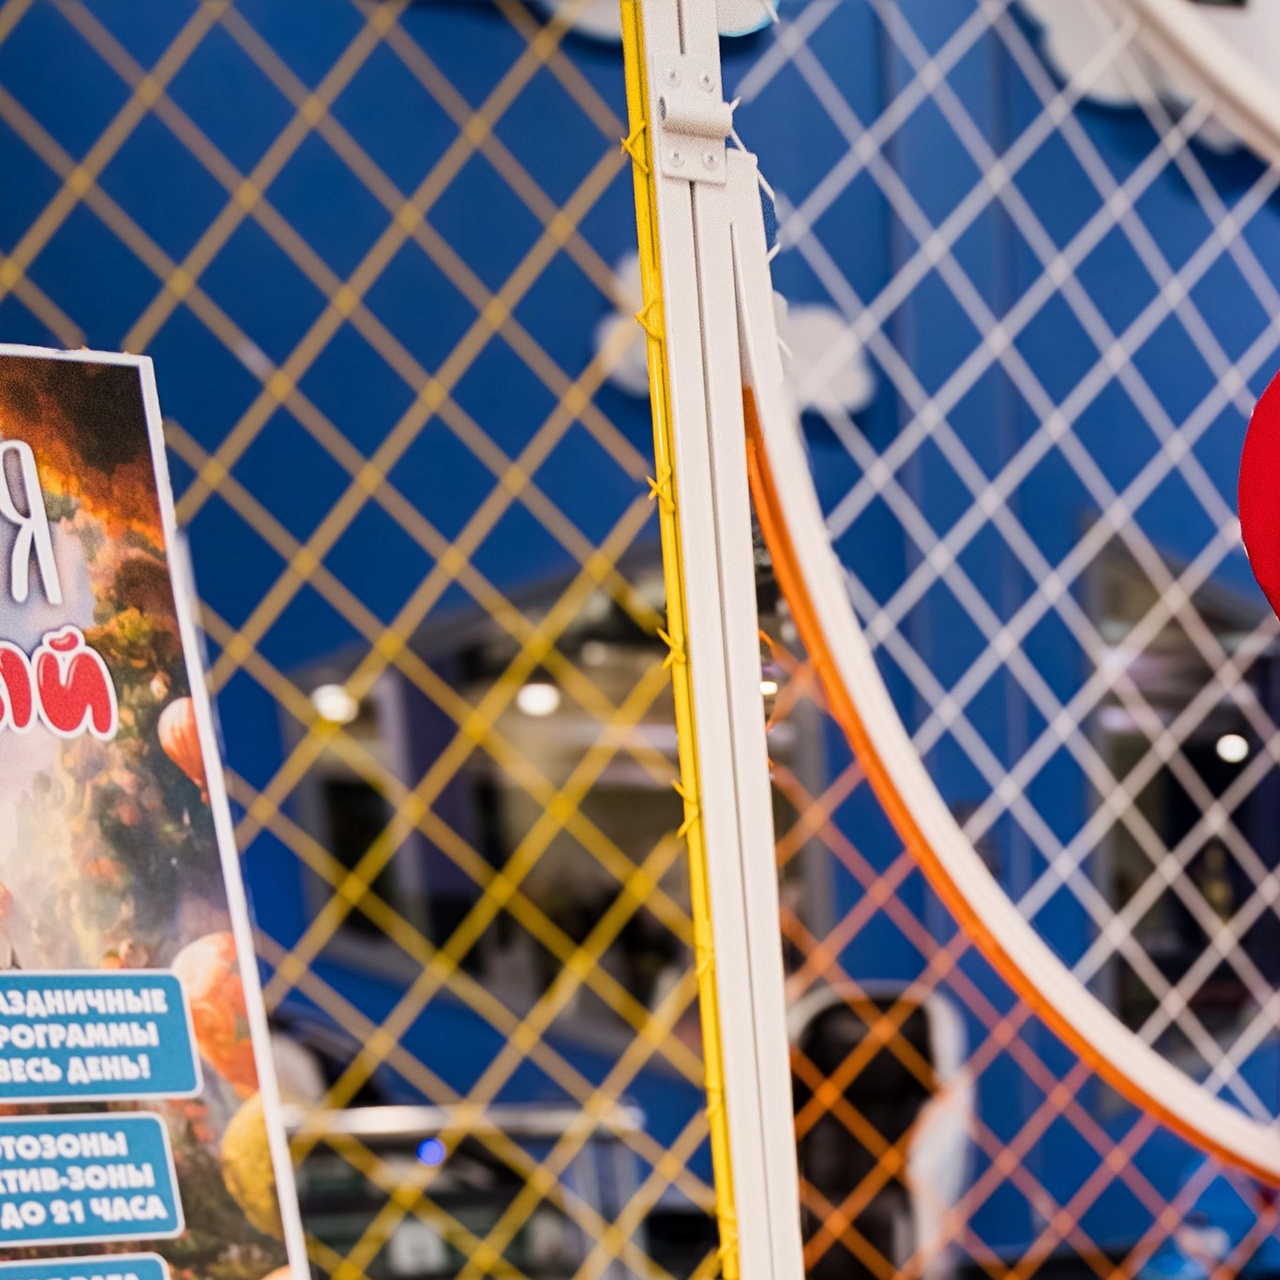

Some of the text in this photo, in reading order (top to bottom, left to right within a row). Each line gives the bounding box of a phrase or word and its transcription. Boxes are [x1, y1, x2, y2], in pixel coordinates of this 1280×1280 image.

[67, 1053, 151, 1085] ДЕНЬ!
[1, 1195, 169, 1229] ДО 21 ЧАСА
